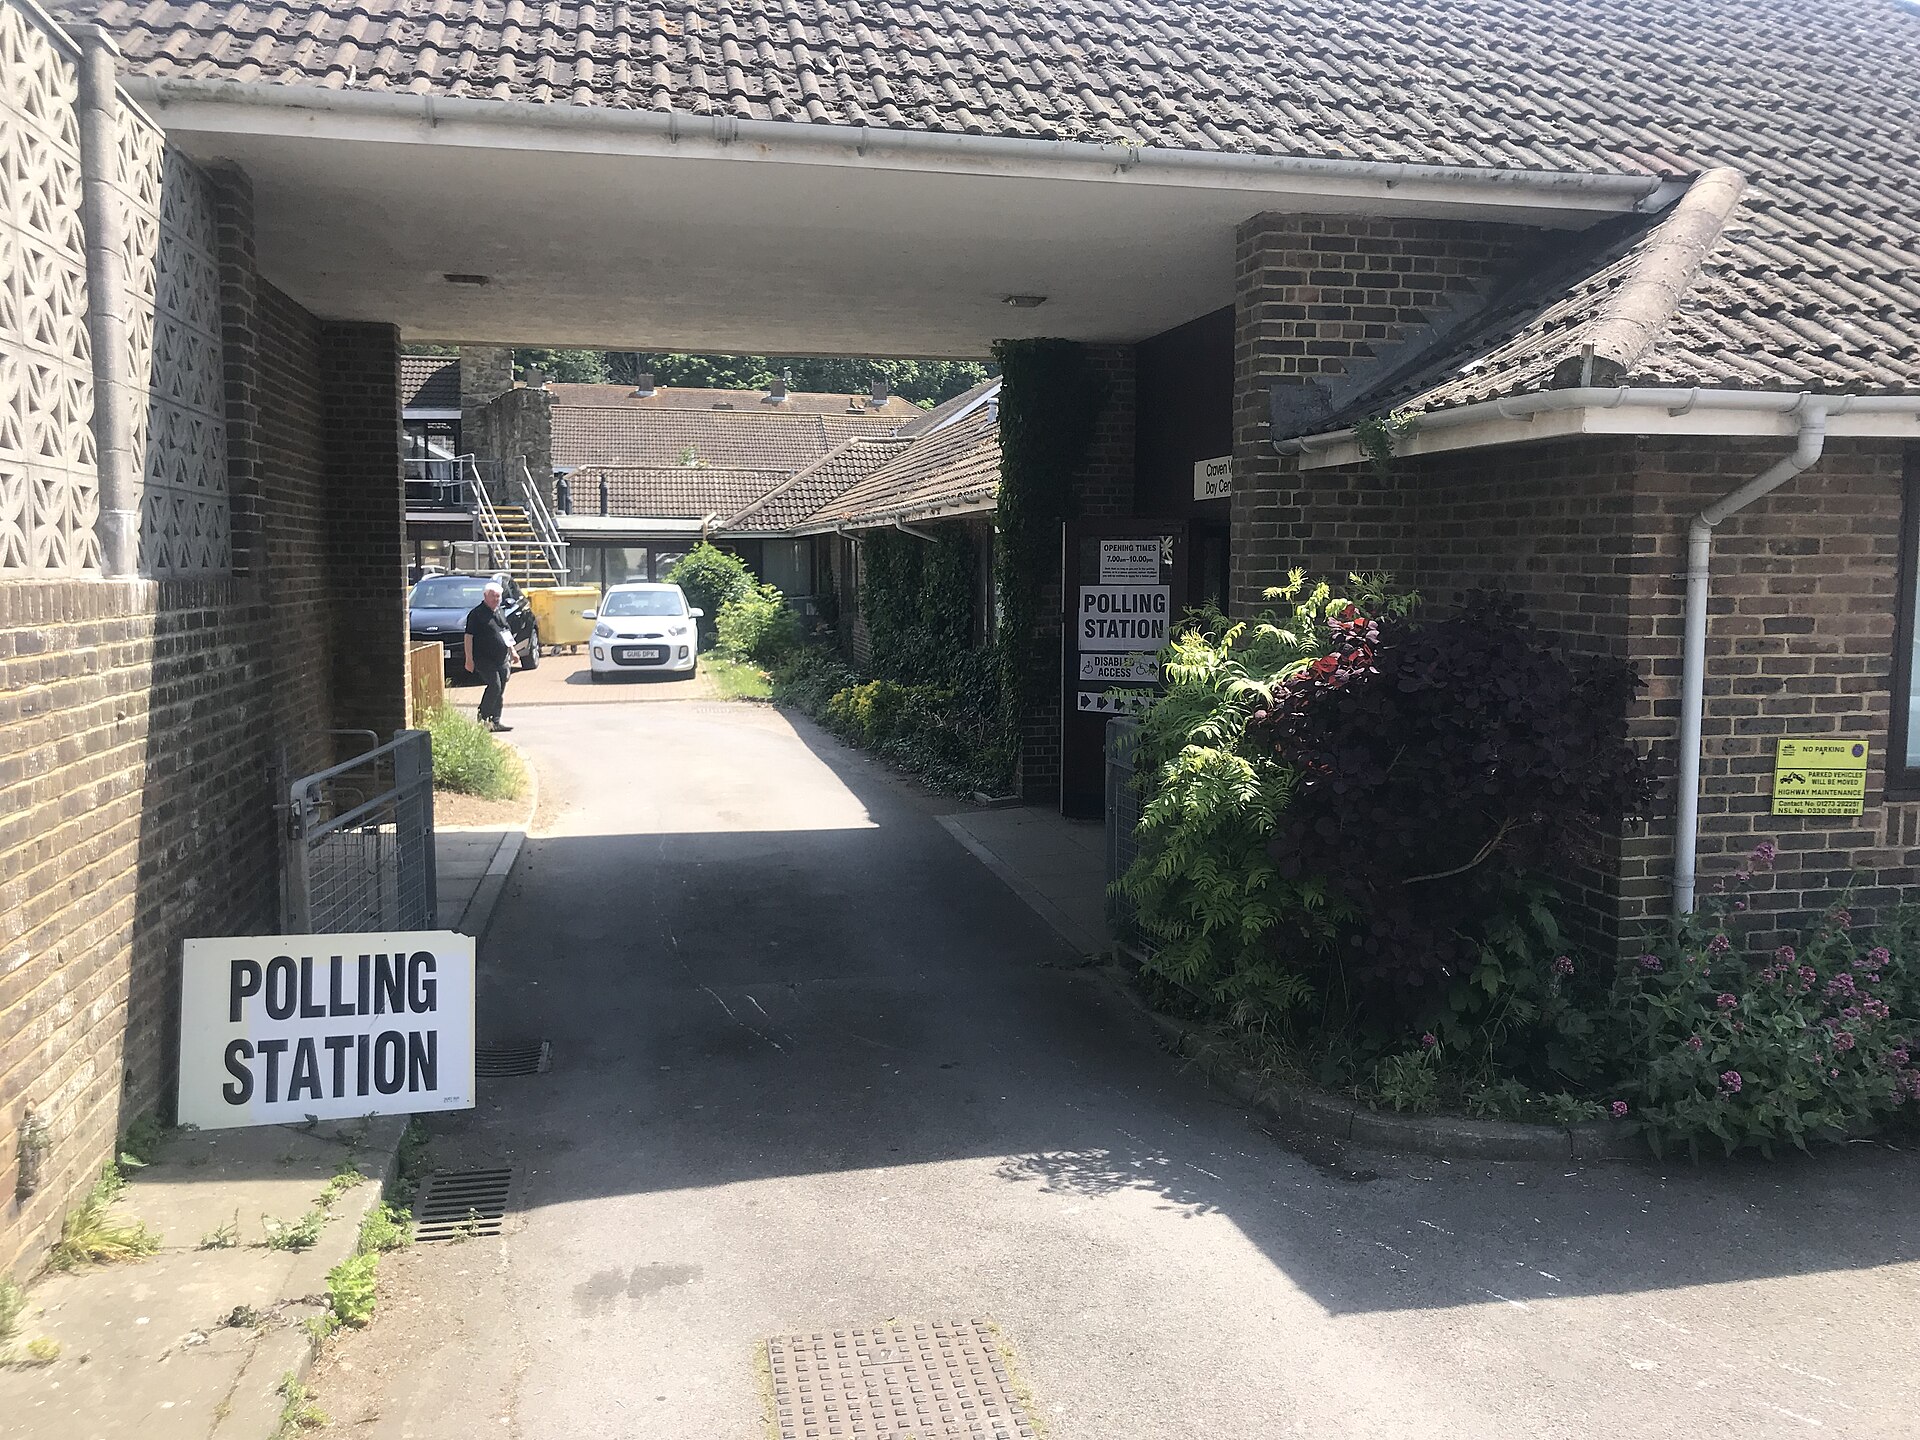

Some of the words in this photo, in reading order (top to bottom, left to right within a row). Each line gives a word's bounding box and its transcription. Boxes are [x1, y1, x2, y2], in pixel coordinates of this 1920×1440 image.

[1206, 463, 1227, 477] Craven
[1205, 481, 1218, 497] Day
[1218, 479, 1232, 493] Cen
[1104, 544, 1133, 552] OPENING
[1135, 544, 1157, 552] TIMES
[1084, 593, 1166, 613] POLLING
[1084, 619, 1164, 639] STATION
[1097, 667, 1132, 678] ACCESS
[229, 950, 438, 1023] POLLING
[221, 1029, 438, 1106] STATION
